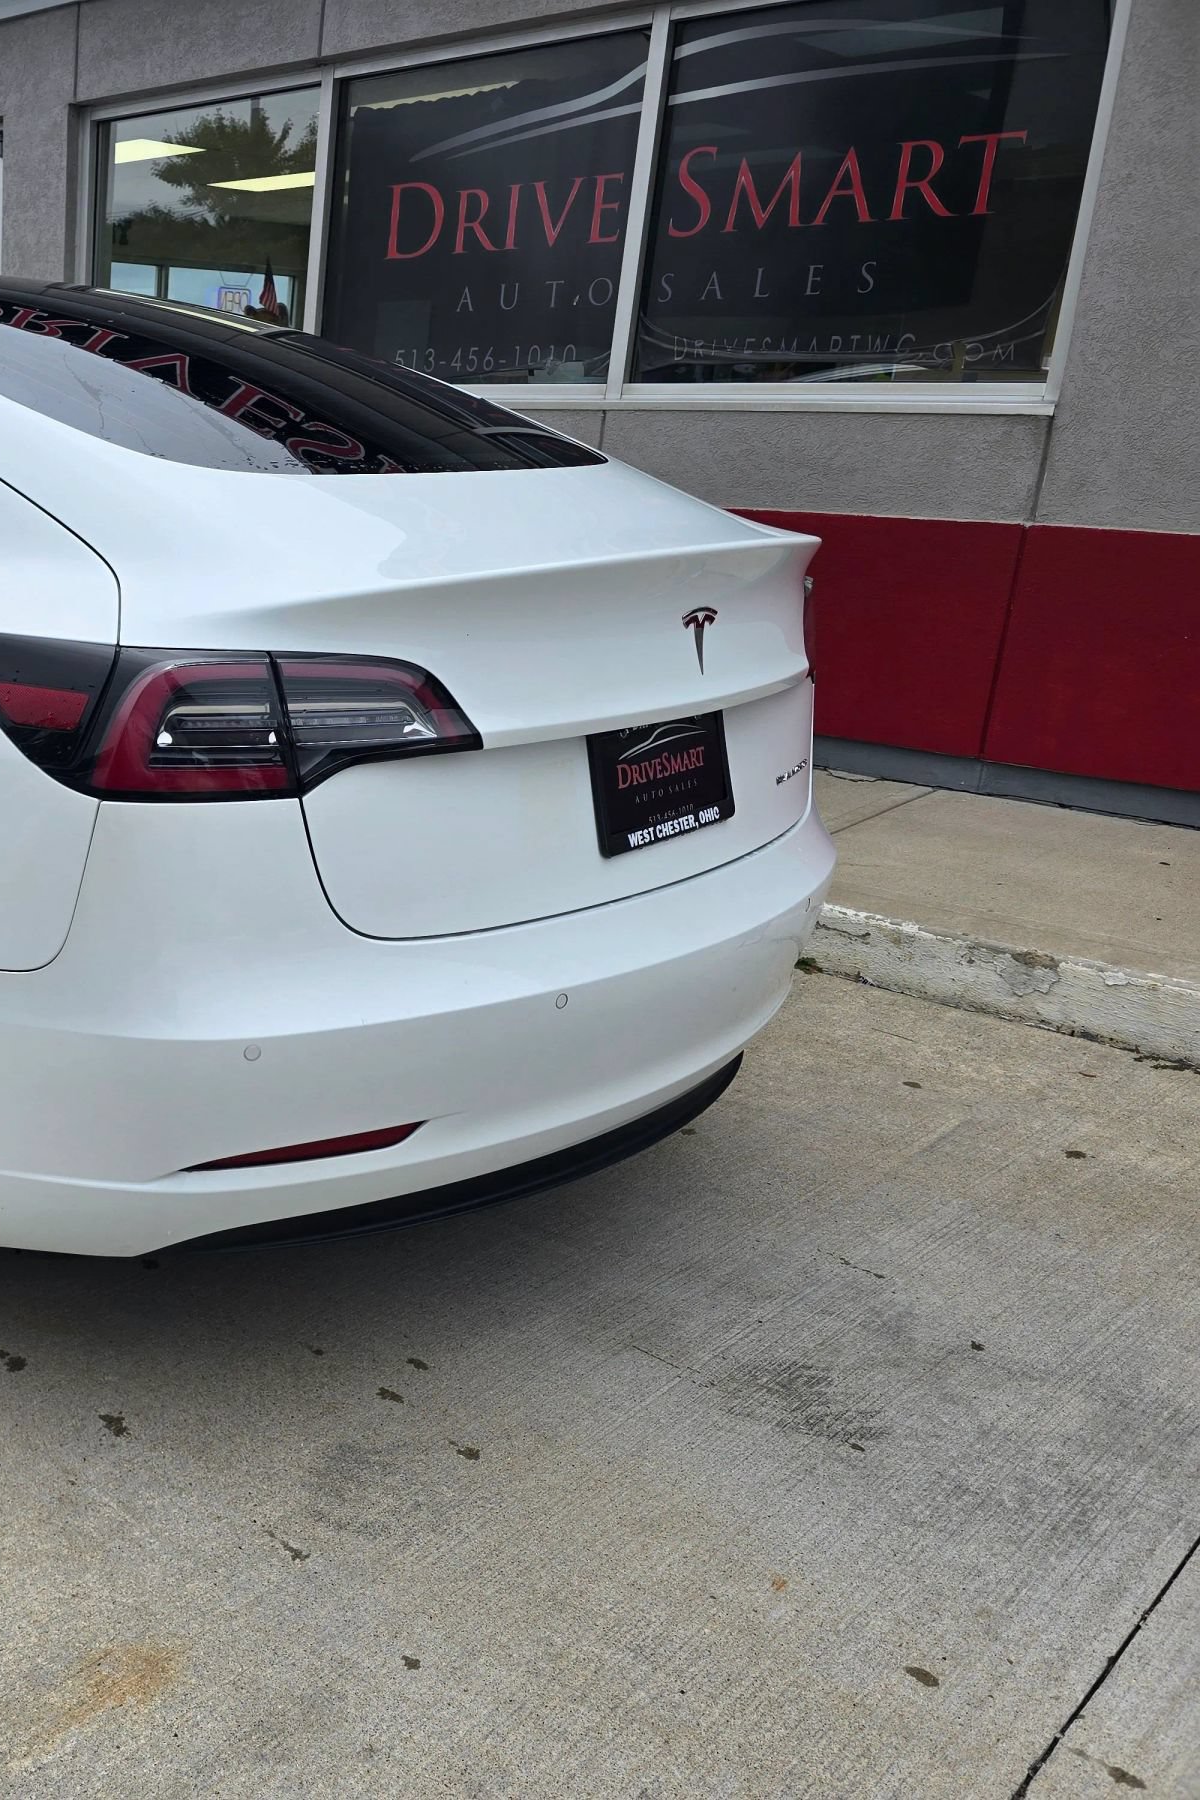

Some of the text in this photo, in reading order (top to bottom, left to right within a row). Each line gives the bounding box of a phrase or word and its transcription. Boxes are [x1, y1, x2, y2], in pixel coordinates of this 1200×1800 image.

[668, 130, 1029, 238] SMART
[456, 261, 878, 313] AUTO SALES
[635, 778, 698, 804] AUTO SALES
[627, 827, 656, 848] WEST
[655, 814, 699, 840] CHESTER,
